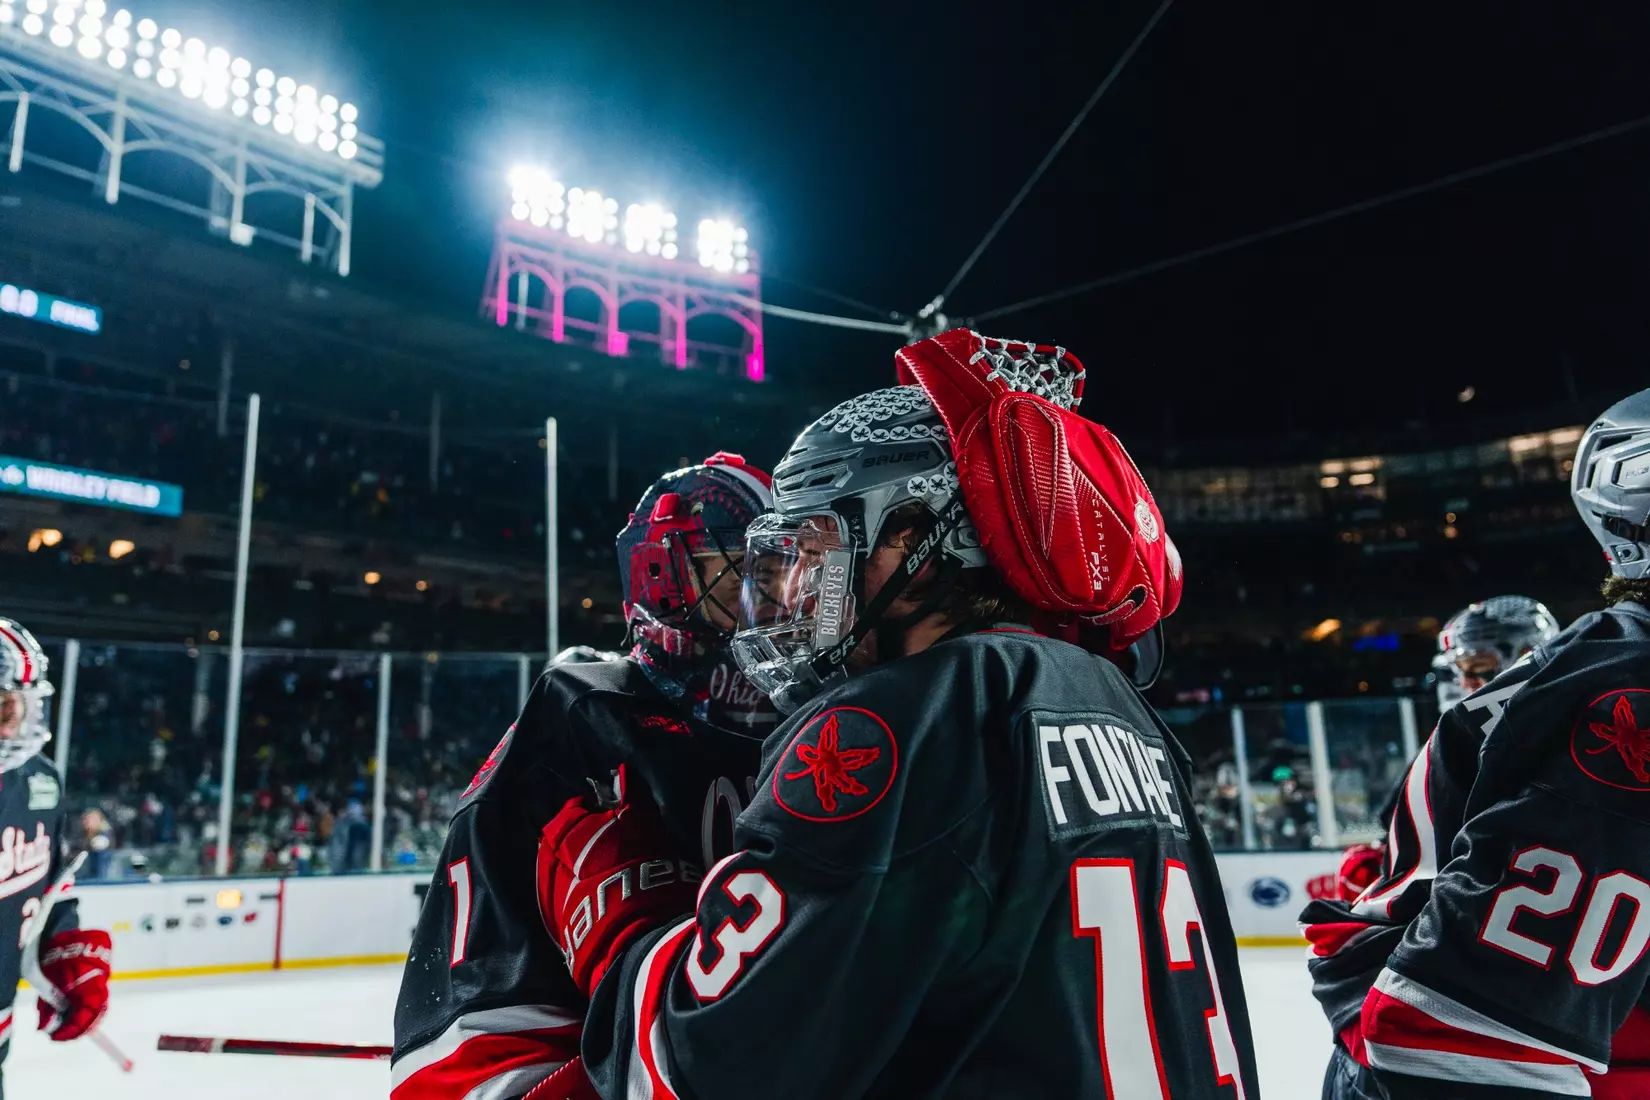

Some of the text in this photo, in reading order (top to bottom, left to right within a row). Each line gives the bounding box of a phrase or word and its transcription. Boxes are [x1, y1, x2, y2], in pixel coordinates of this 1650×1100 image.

[862, 450, 930, 468] BAUER
[821, 565, 845, 636] BUCKEYES
[447, 857, 472, 968] 1
[1477, 844, 1650, 987] 20
